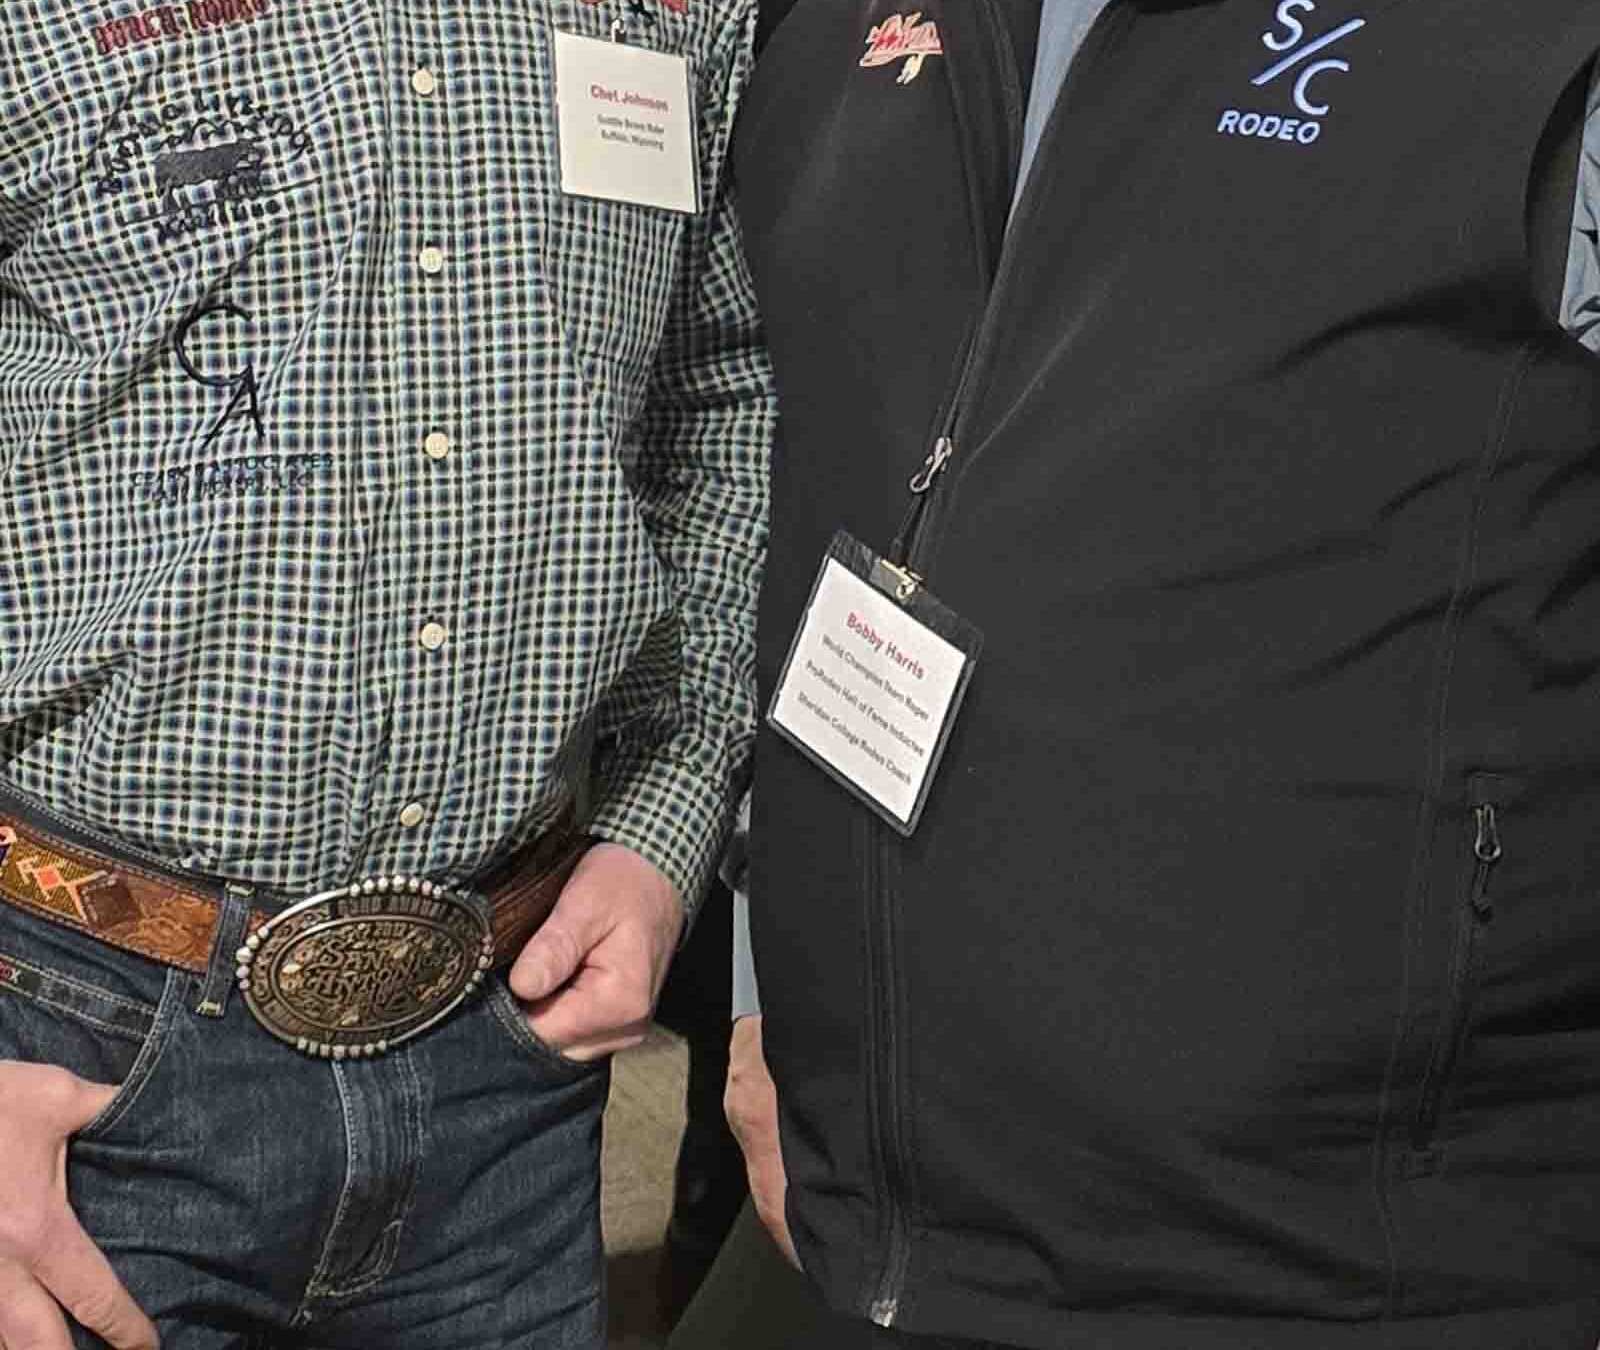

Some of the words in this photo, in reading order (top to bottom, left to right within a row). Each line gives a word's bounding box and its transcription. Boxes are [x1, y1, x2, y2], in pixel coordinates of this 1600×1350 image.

[1217, 109, 1320, 144] RODEO
[847, 612, 884, 653] Bobby
[886, 642, 925, 680] Harris
